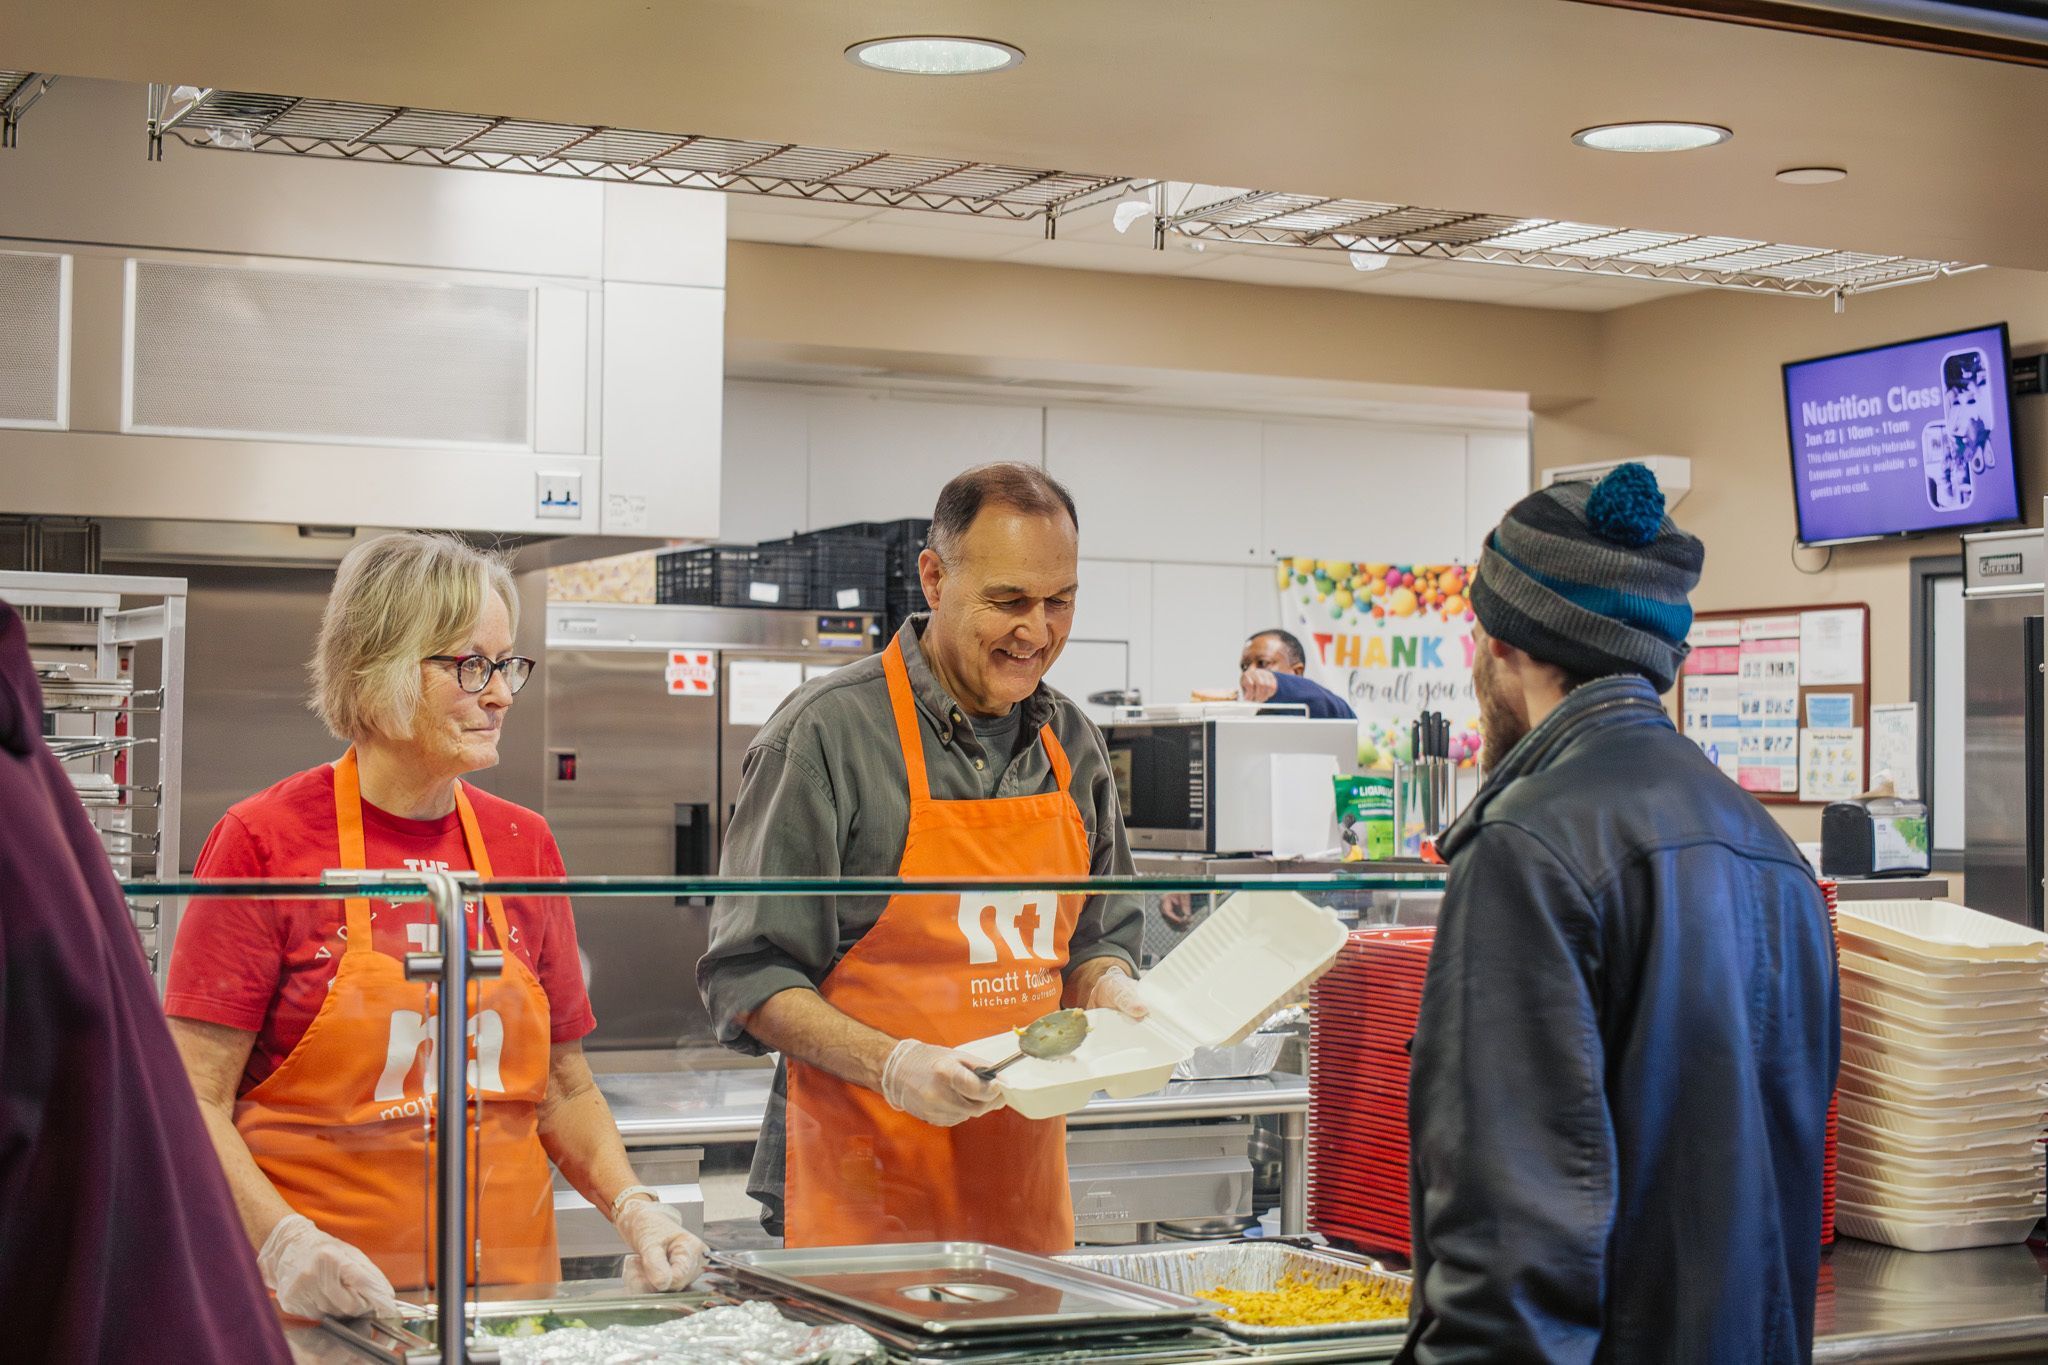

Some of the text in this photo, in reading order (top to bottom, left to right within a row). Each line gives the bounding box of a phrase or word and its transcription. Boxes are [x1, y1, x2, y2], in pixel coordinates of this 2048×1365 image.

[1802, 385, 1941, 427] Nutrition Class
[1805, 432, 1822, 447] Jan
[1824, 429, 1836, 444] 22
[1847, 425, 1874, 440] 10am
[1882, 421, 1910, 435] 11am
[1313, 633, 1443, 668] THANK
[1347, 670, 1375, 704] for
[1381, 671, 1413, 701] all
[1418, 682, 1456, 710] you
[971, 971, 1019, 994] matt
[972, 996, 1017, 1008] kitchen
[1021, 992, 1029, 1003] &
